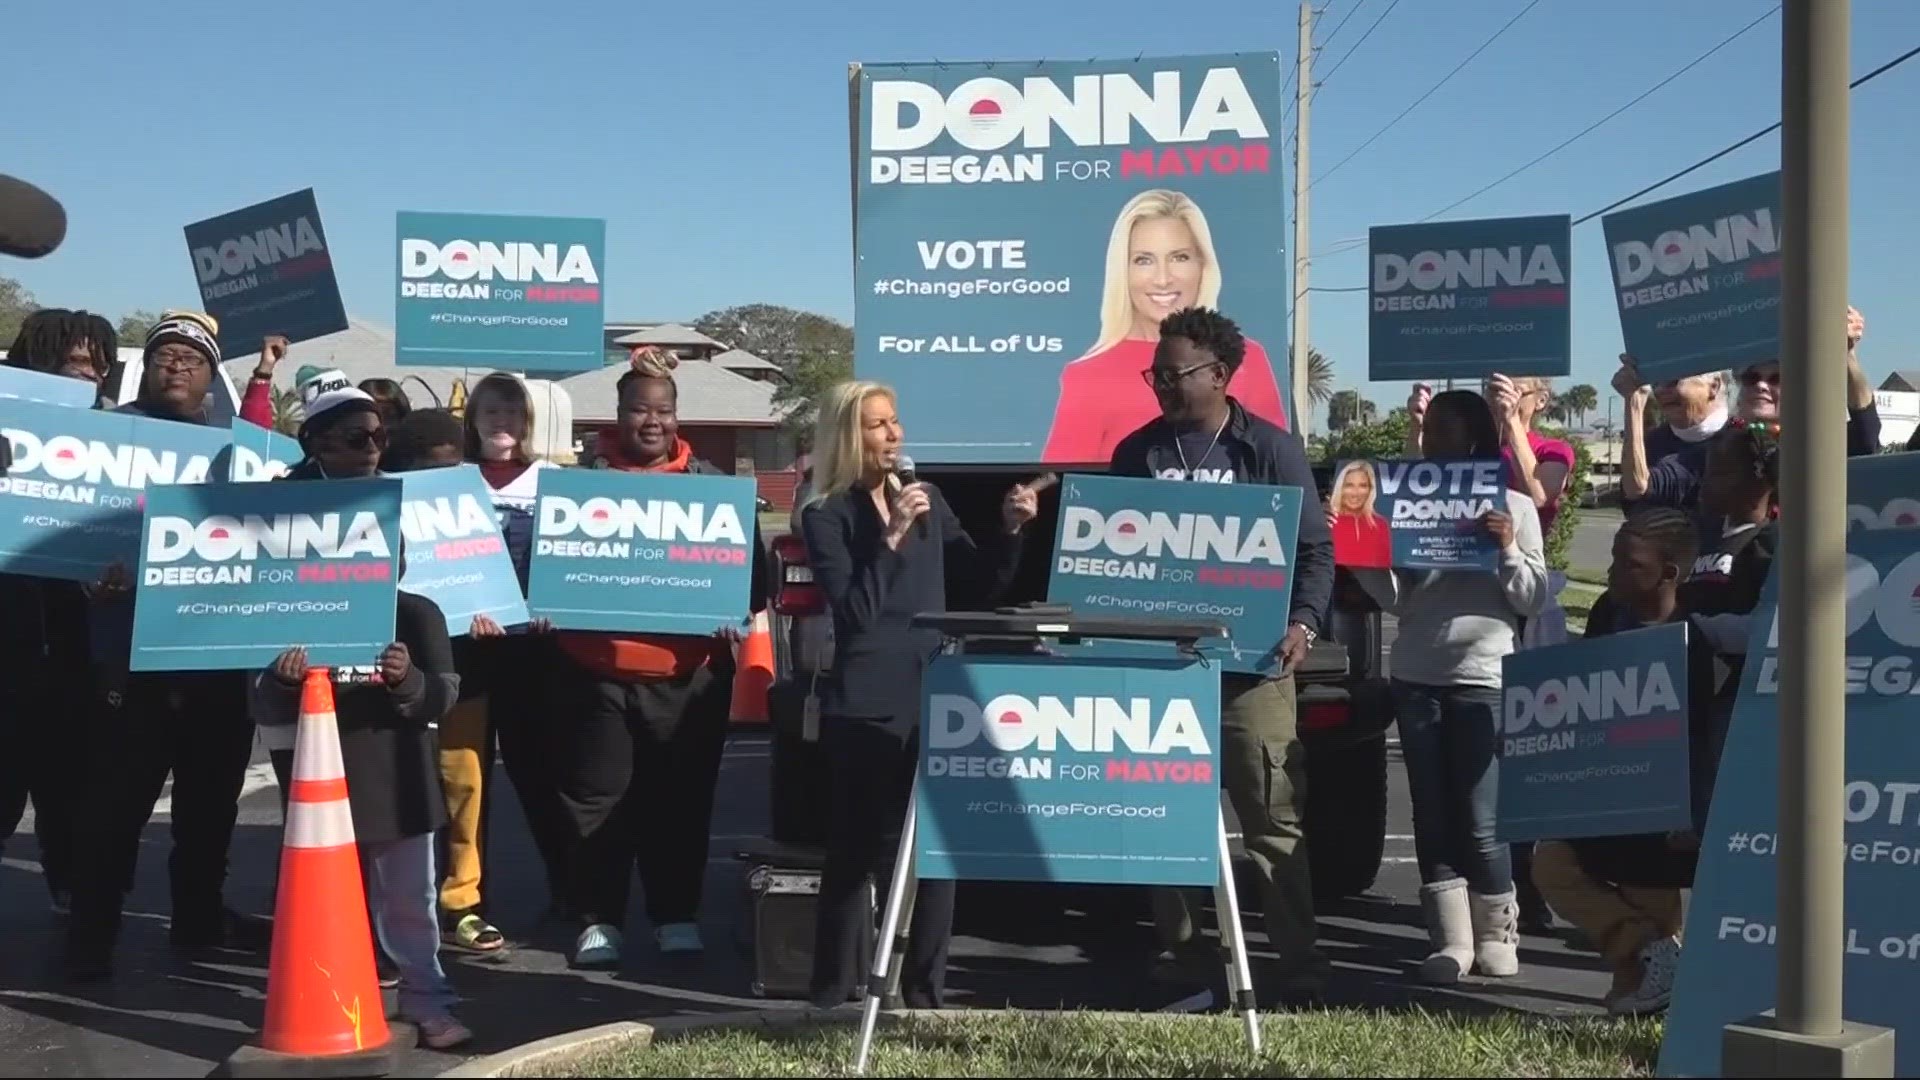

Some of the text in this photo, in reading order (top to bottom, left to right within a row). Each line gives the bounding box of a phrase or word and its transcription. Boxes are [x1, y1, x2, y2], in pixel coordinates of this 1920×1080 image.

[871, 67, 1269, 151] DONNA
[871, 144, 1270, 184] DEEGAN FOR MAYOR
[194, 216, 324, 283] DONNA
[402, 238, 599, 284] DONNA
[918, 240, 1026, 270] VOTE
[1613, 207, 1783, 288] DONN
[1374, 245, 1565, 293] DONNA
[401, 281, 490, 300] DEEGAN
[494, 288, 523, 301] FOR
[874, 277, 1070, 297] #ChangeForGood
[1622, 274, 1709, 309] DEEGAN
[1374, 293, 1456, 312] DEEGAN
[430, 313, 568, 327] #ChangeForGood
[1400, 321, 1535, 335] #ChangeForGood
[879, 335, 1064, 353] For ALL of Us
[0, 476, 95, 504] DEEGAN
[100, 494, 132, 509] FOR
[1378, 462, 1501, 496] VOTE
[538, 496, 747, 545] DONNA
[147, 511, 391, 562] DONNA
[1060, 506, 1286, 566] DONNA
[537, 540, 747, 565] DEEGAN FOR MAYOR
[144, 565, 252, 586] DEEGAN
[258, 569, 293, 583] FOR
[565, 573, 712, 588] #ChangeForGood
[1058, 556, 1156, 581] DEEGAN
[1161, 567, 1194, 583] FOR
[176, 601, 349, 615] #ChangeForGood
[1085, 594, 1244, 617] #ChangeForGood
[1503, 662, 1681, 734] DONNA
[929, 694, 1212, 755] DONNA
[1503, 731, 1575, 757] DEEGAN
[928, 755, 1212, 783] DEEGAN FOR MAYOR
[1524, 761, 1651, 784] #ChangeForGood
[967, 800, 1166, 818] #ChangeForGood
